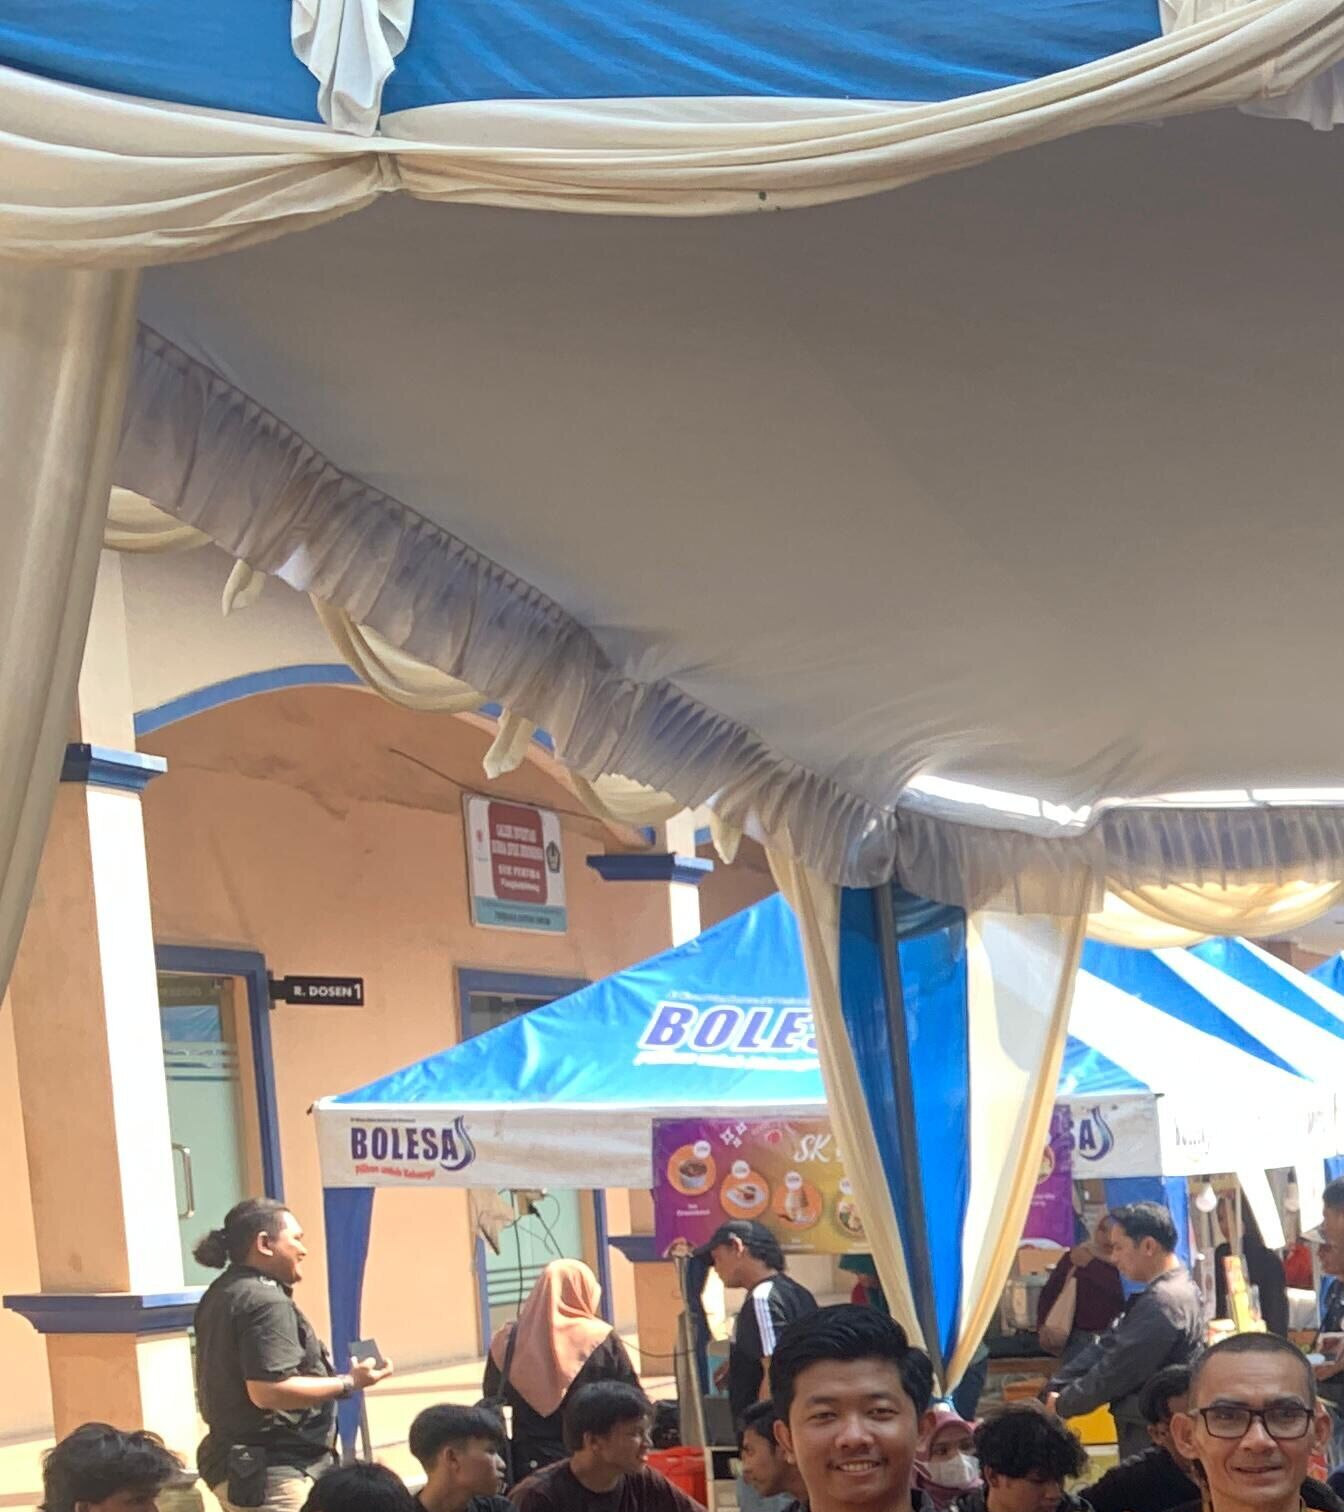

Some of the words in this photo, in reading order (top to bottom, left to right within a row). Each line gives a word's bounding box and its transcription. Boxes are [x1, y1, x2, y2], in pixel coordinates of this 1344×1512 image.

[309, 985, 352, 997] DOSEN
[354, 983, 361, 1000] 1
[638, 1002, 818, 1052] BOLE
[351, 1127, 459, 1161] BOLESA
[793, 1133, 832, 1163] SK
